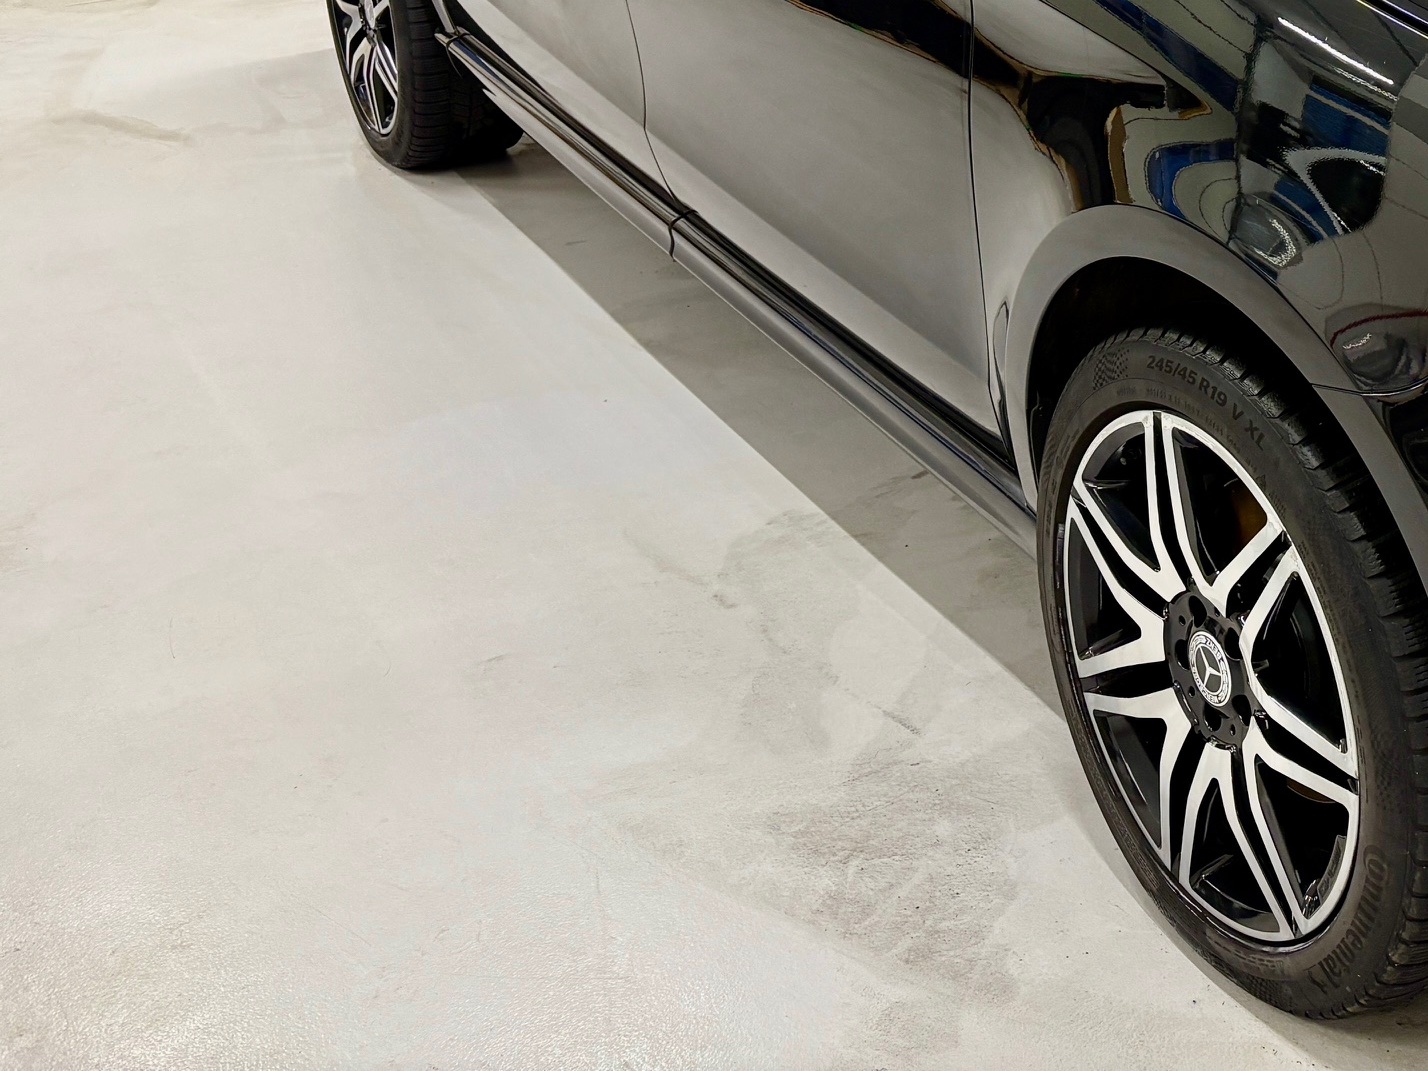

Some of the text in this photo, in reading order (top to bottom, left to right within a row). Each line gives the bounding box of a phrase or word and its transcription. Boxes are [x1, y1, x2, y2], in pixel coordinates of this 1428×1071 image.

[1147, 355, 1197, 386] 245/45
[1199, 377, 1228, 407] R19
[1231, 403, 1245, 421] V
[1245, 419, 1268, 451] XL
[1317, 845, 1389, 989] Continental
